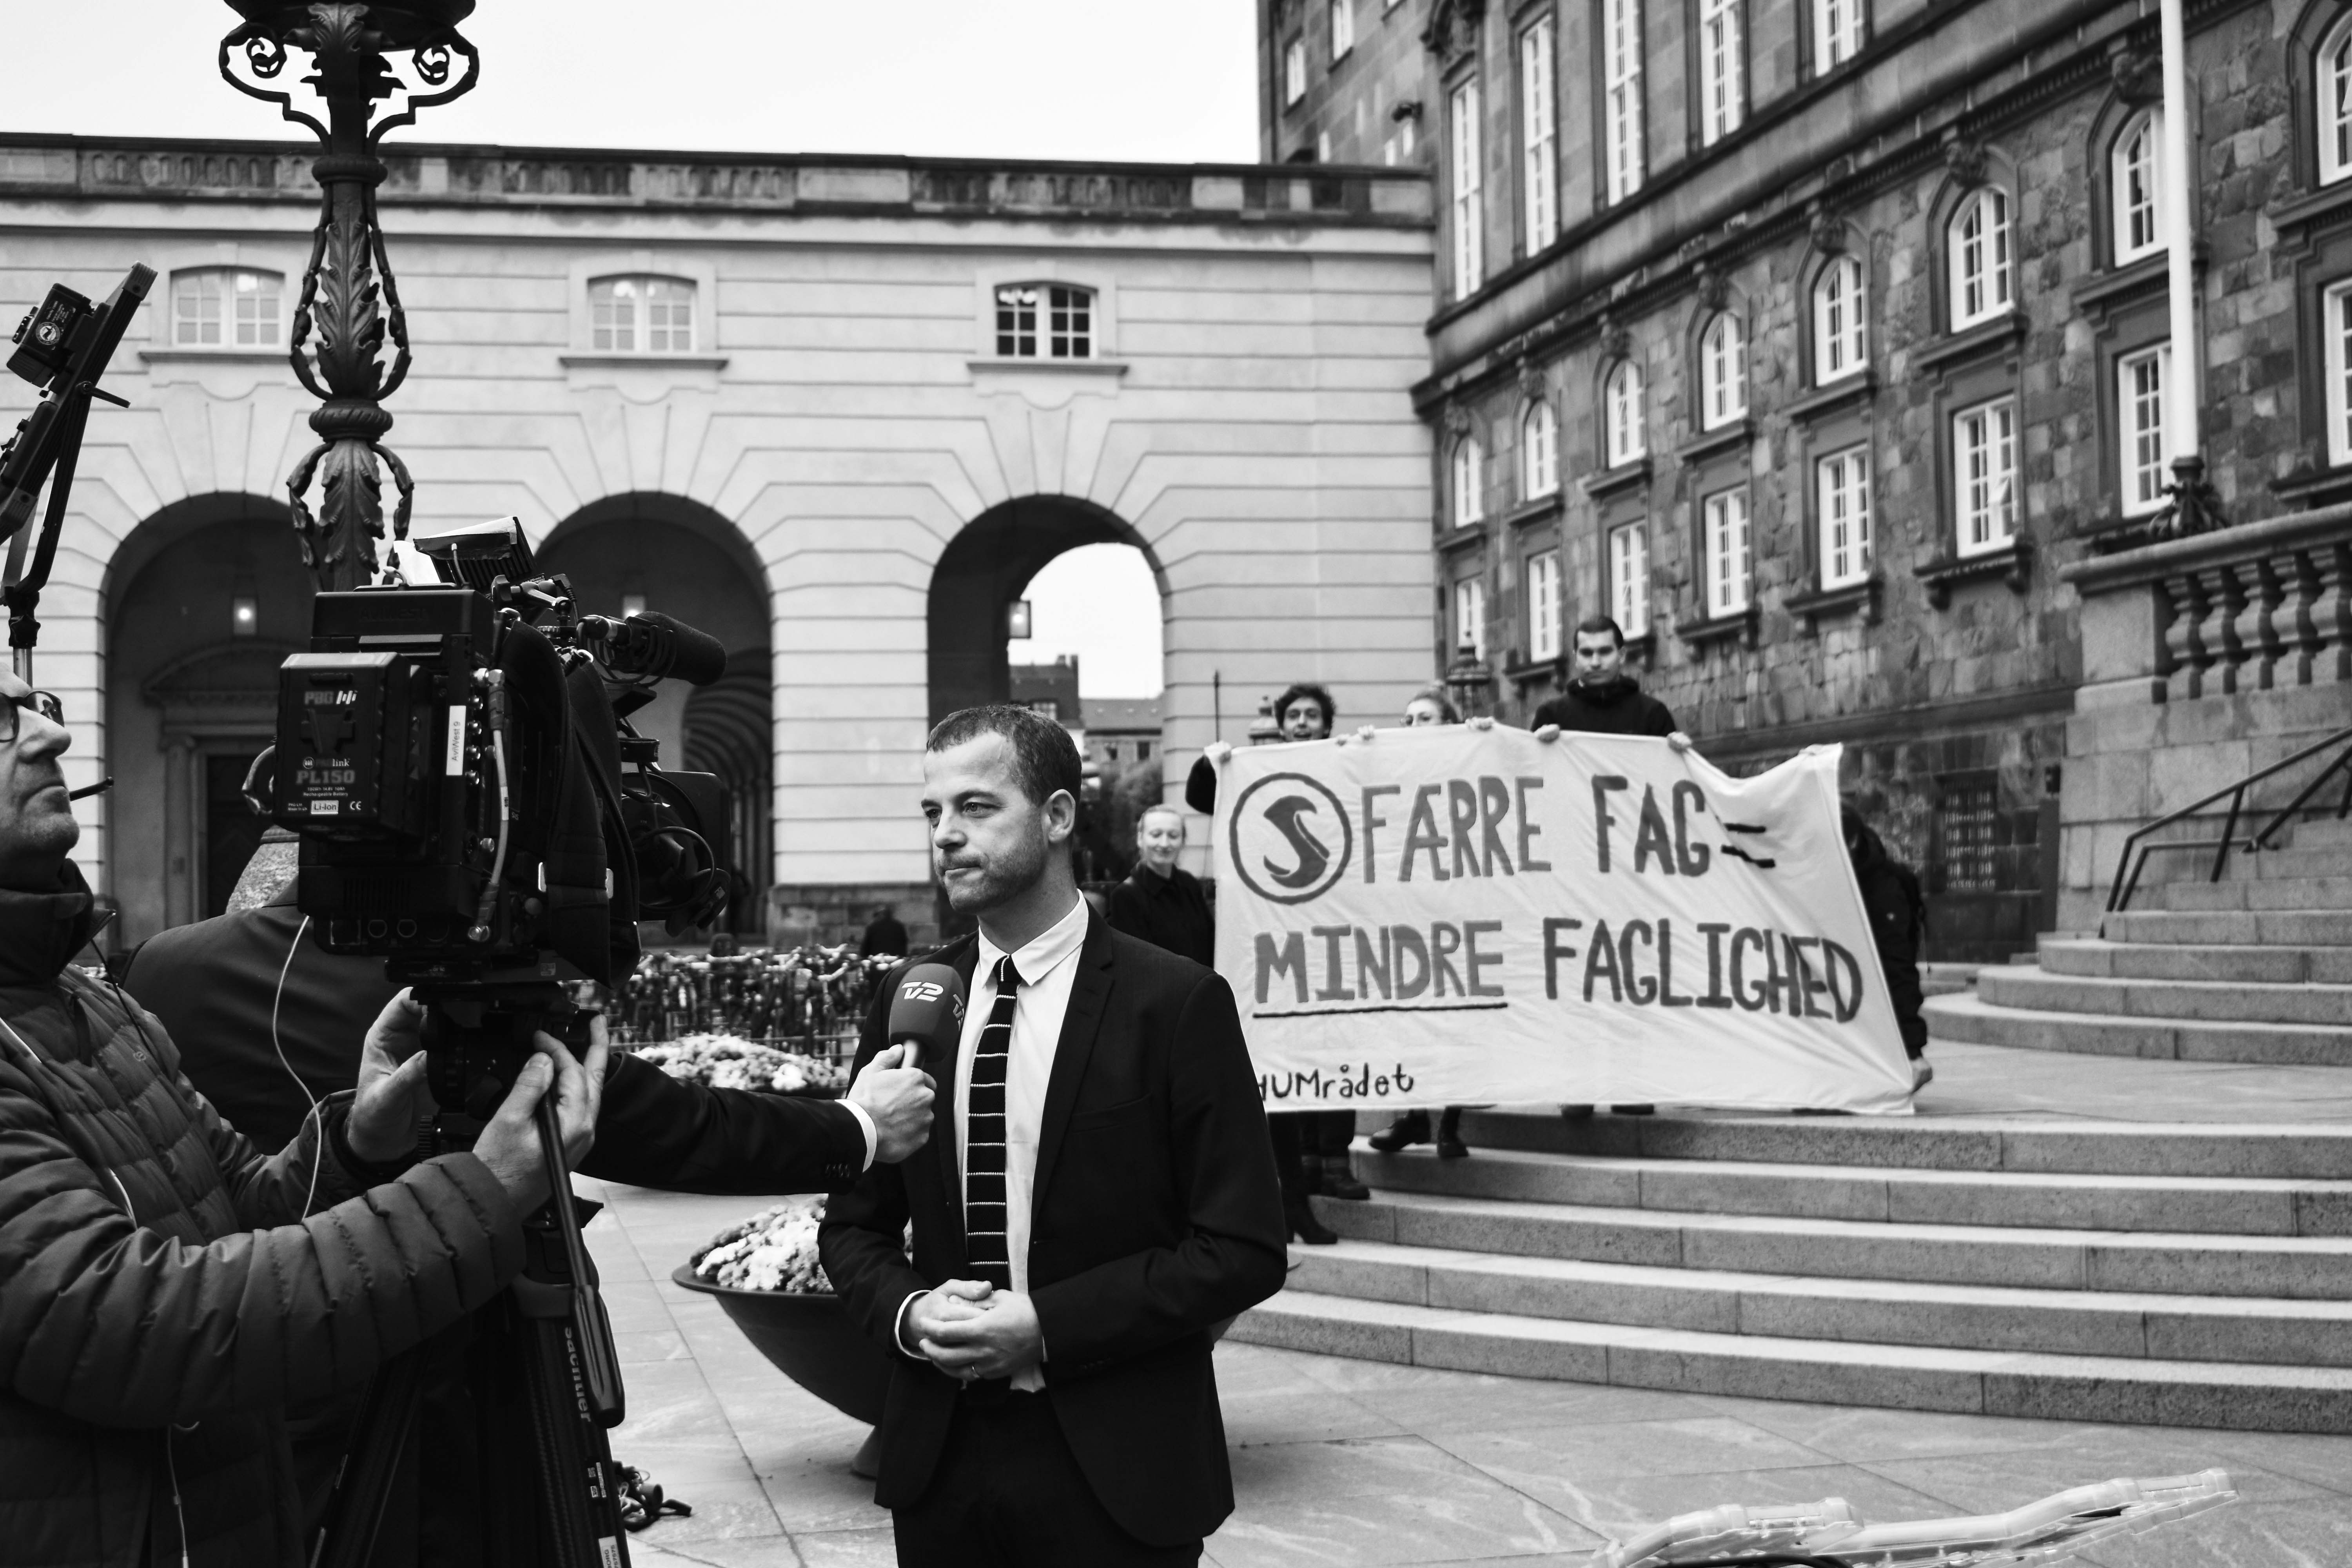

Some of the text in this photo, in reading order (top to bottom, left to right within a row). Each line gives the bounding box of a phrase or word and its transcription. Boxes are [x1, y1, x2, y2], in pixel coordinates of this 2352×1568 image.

[452, 729, 460, 762] AviWest
[296, 769, 356, 784] PL150
[350, 801, 361, 810] CE
[1363, 776, 1551, 883] FÆRRE
[1254, 917, 1863, 1023] MINDRE FAGLIGHED
